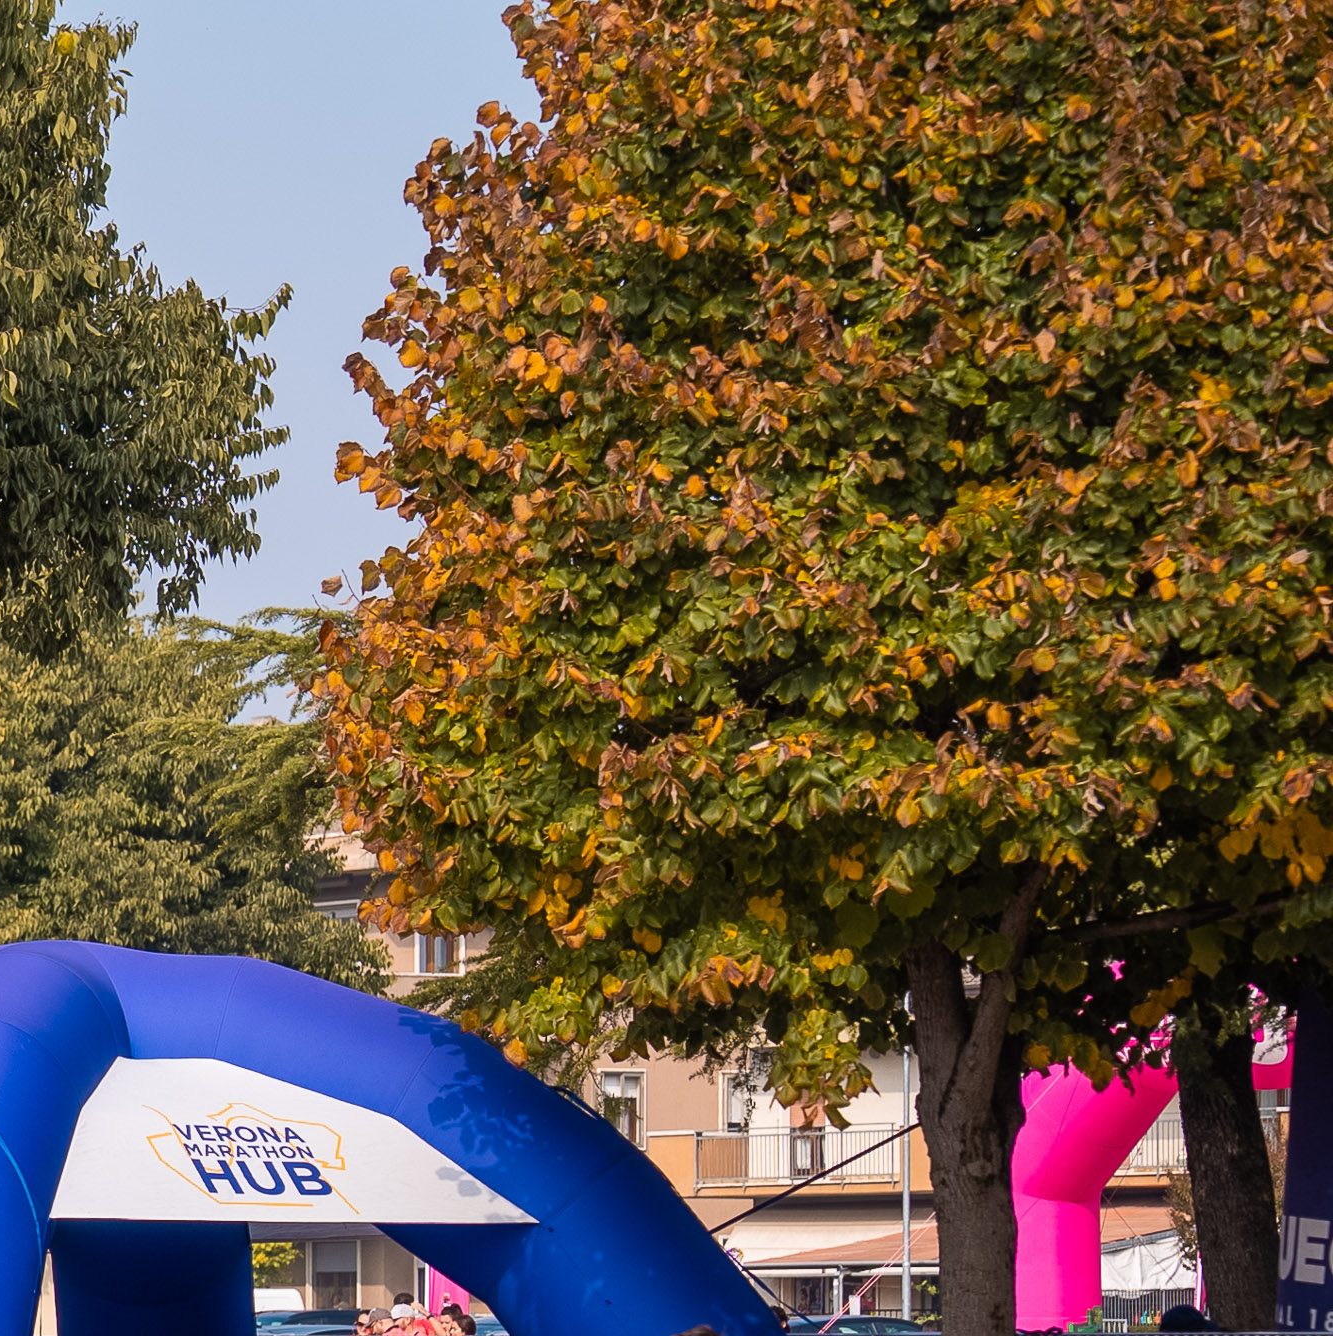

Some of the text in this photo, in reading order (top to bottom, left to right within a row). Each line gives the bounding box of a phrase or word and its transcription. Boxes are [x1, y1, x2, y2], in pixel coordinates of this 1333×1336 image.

[172, 1123, 306, 1143] VERONA
[183, 1143, 315, 1159] MARATHON
[191, 1158, 333, 1195] HUB
